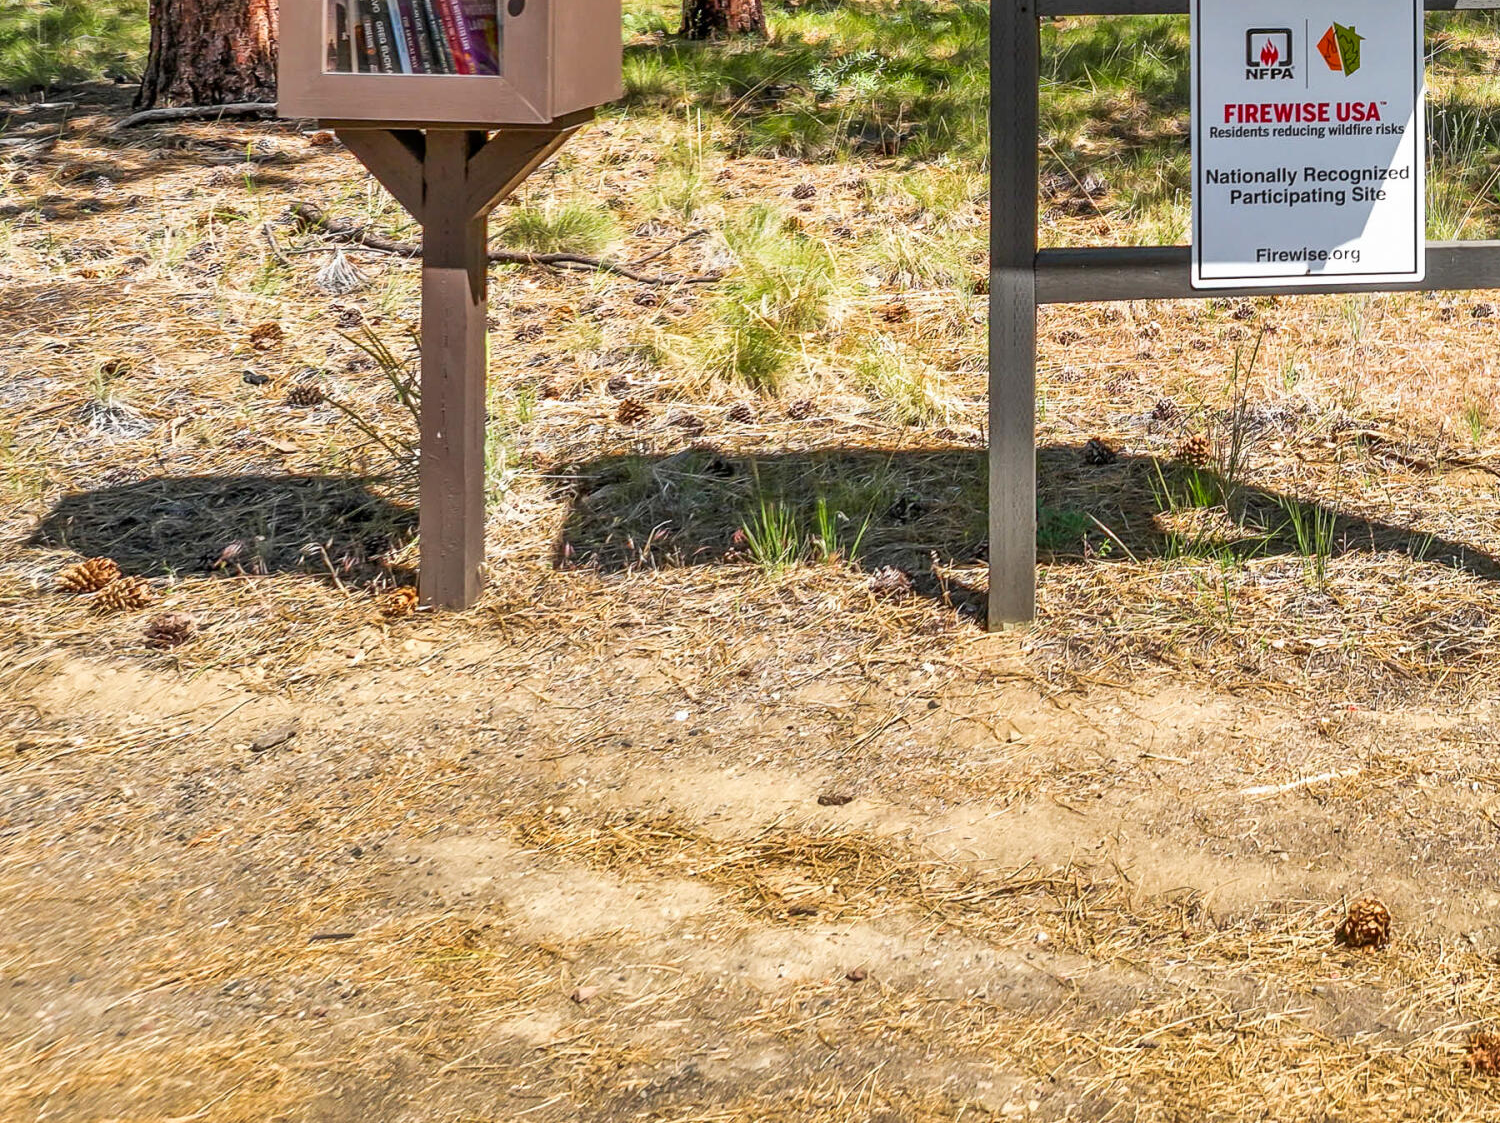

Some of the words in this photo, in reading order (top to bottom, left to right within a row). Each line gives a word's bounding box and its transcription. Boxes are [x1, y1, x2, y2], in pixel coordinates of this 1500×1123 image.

[1246, 68, 1295, 80] NFPA
[1224, 102, 1330, 124] FIREWISE
[1209, 126, 1270, 139] Residents
[1272, 125, 1326, 139] reducing
[1328, 123, 1373, 136] wildfire
[1376, 123, 1405, 135] risks
[1206, 167, 1298, 186] Nationally
[1304, 166, 1410, 185] Recognized
[1230, 188, 1346, 207] Participating
[1351, 186, 1387, 202] Site
[1256, 247, 1361, 263] Firewise.org
